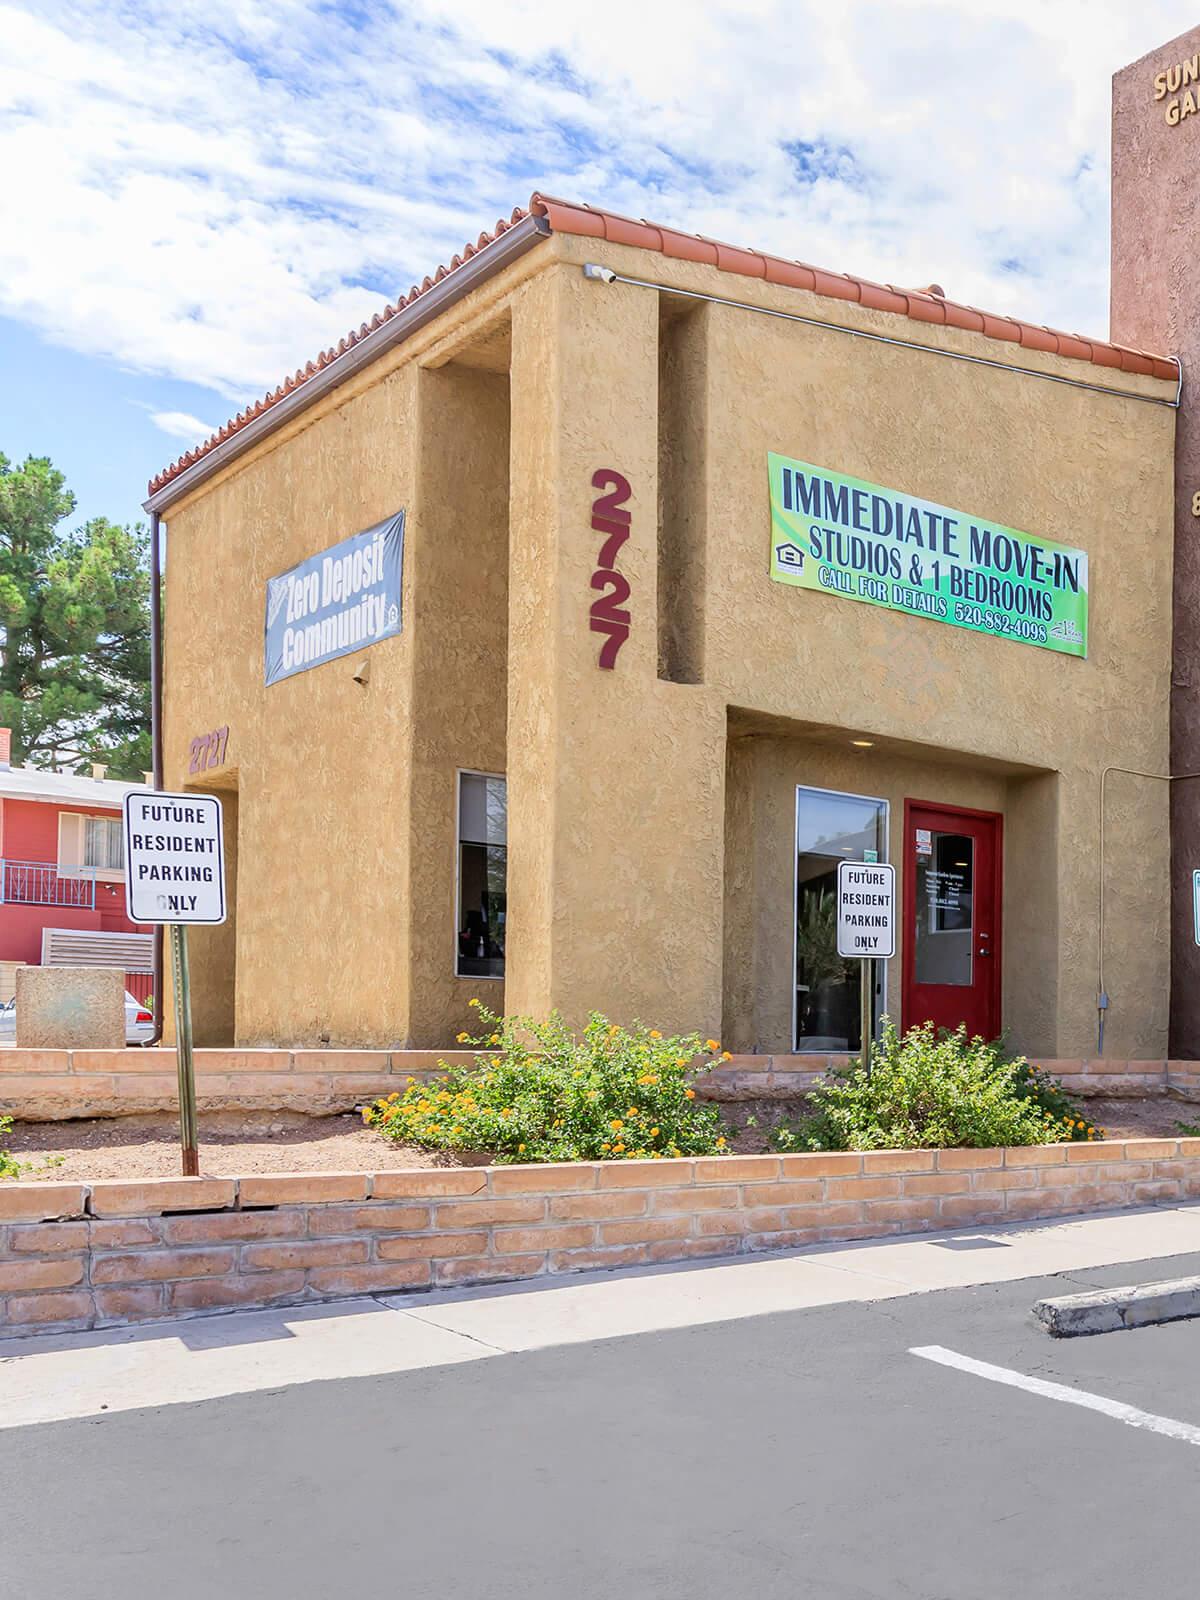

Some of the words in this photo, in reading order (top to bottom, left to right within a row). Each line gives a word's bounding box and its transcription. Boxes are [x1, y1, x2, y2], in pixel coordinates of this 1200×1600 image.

[782, 467, 960, 558] IMMEDIATE
[969, 526, 1079, 593] MOVE-IN
[286, 571, 319, 624] Zero
[322, 533, 385, 607] Deposit
[589, 468, 632, 670] 2727
[809, 525, 902, 580] STUDIOS
[909, 554, 923, 587] &
[931, 560, 940, 591] 1
[950, 565, 1053, 622] BEDROOMS
[818, 566, 856, 594] CALL
[858, 577, 888, 603] FOR
[893, 586, 947, 617] DETAILS
[954, 603, 1047, 643] 520-882-4098
[282, 592, 386, 671] Community
[189, 725, 229, 775] 2727
[142, 805, 205, 824] FUTURE
[133, 834, 215, 853] RESIDENT
[139, 864, 213, 882] PARKING
[848, 871, 885, 885] FUTURE
[842, 892, 890, 907] RESIDENT
[845, 914, 888, 927] PARKING
[854, 936, 878, 948] ONLY
